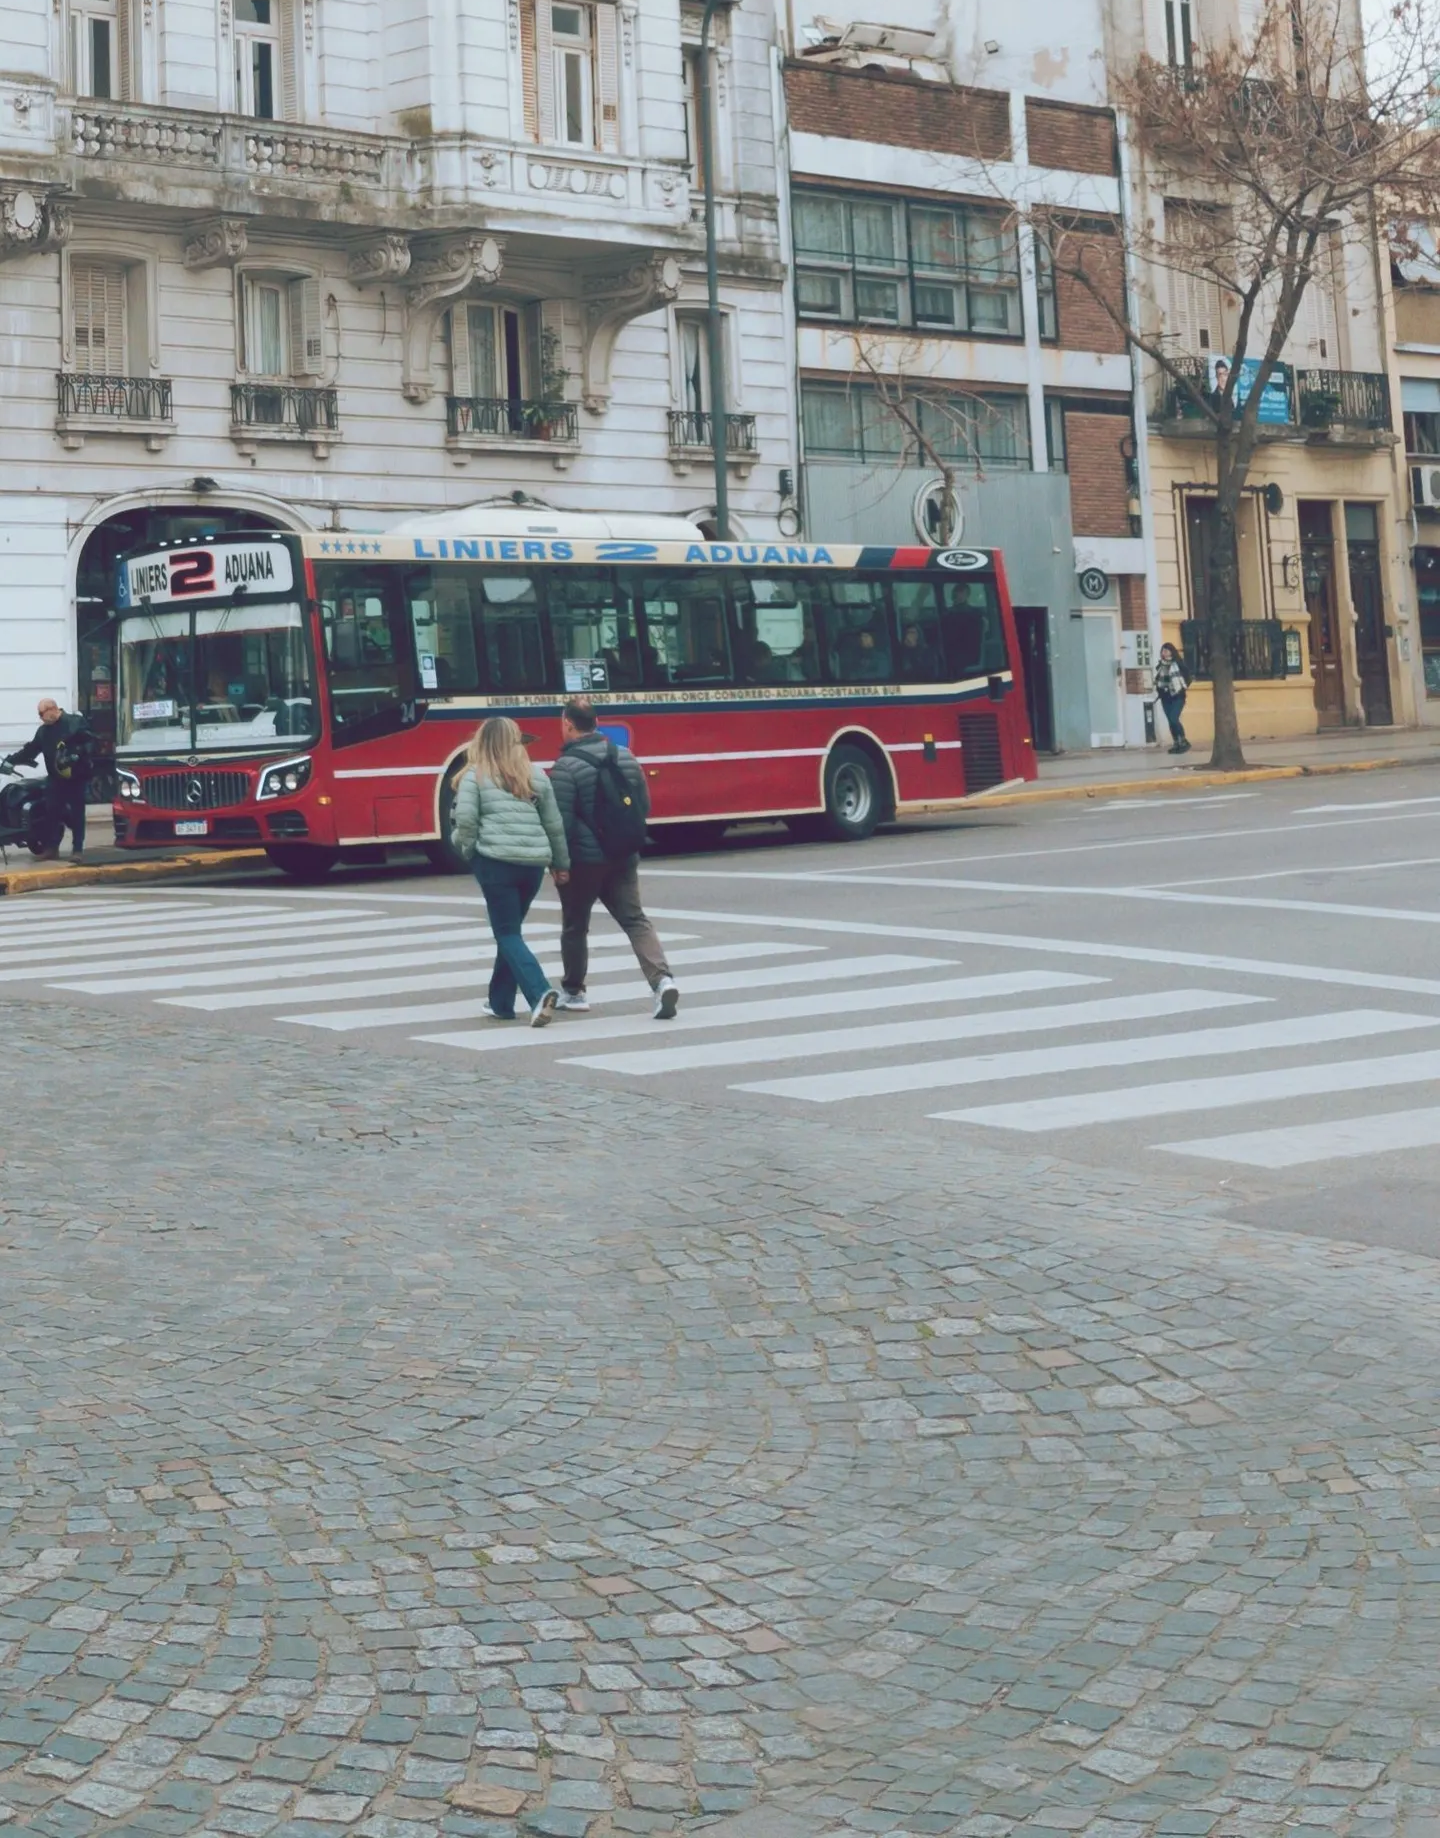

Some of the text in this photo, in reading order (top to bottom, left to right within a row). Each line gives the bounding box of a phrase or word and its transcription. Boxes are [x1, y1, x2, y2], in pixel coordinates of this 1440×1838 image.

[413, 539, 834, 564] LINIERS 2 ADUANA
[131, 551, 274, 596] LINIERS 2 ADUANA
[592, 667, 605, 681] 2
